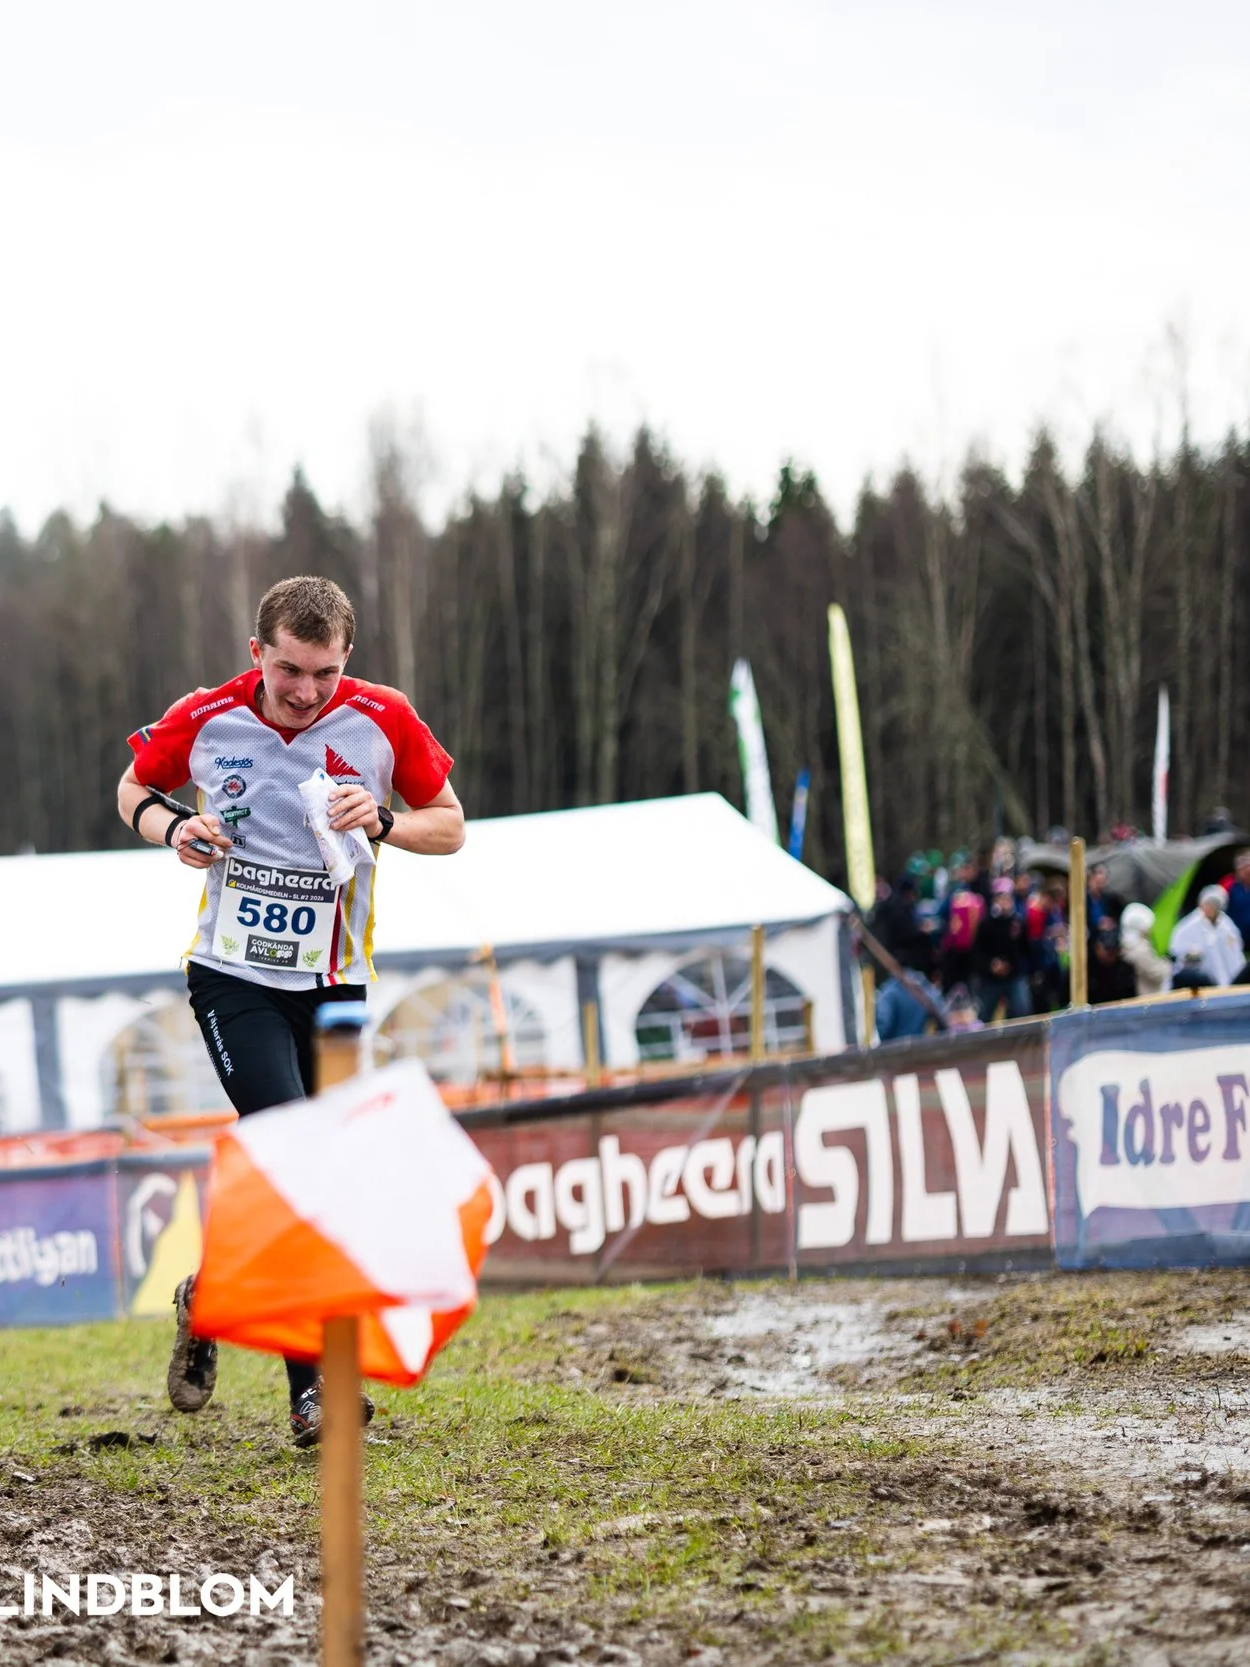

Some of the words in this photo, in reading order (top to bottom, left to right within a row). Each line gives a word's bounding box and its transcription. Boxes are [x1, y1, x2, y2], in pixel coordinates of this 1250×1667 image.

[190, 696, 234, 720] noname
[345, 694, 386, 713] name
[229, 859, 337, 891] bagheera
[236, 896, 316, 935] 580
[221, 1051, 234, 1076] SOK
[1098, 1078, 1211, 1167] Idre
[795, 1059, 1049, 1249] SILVA
